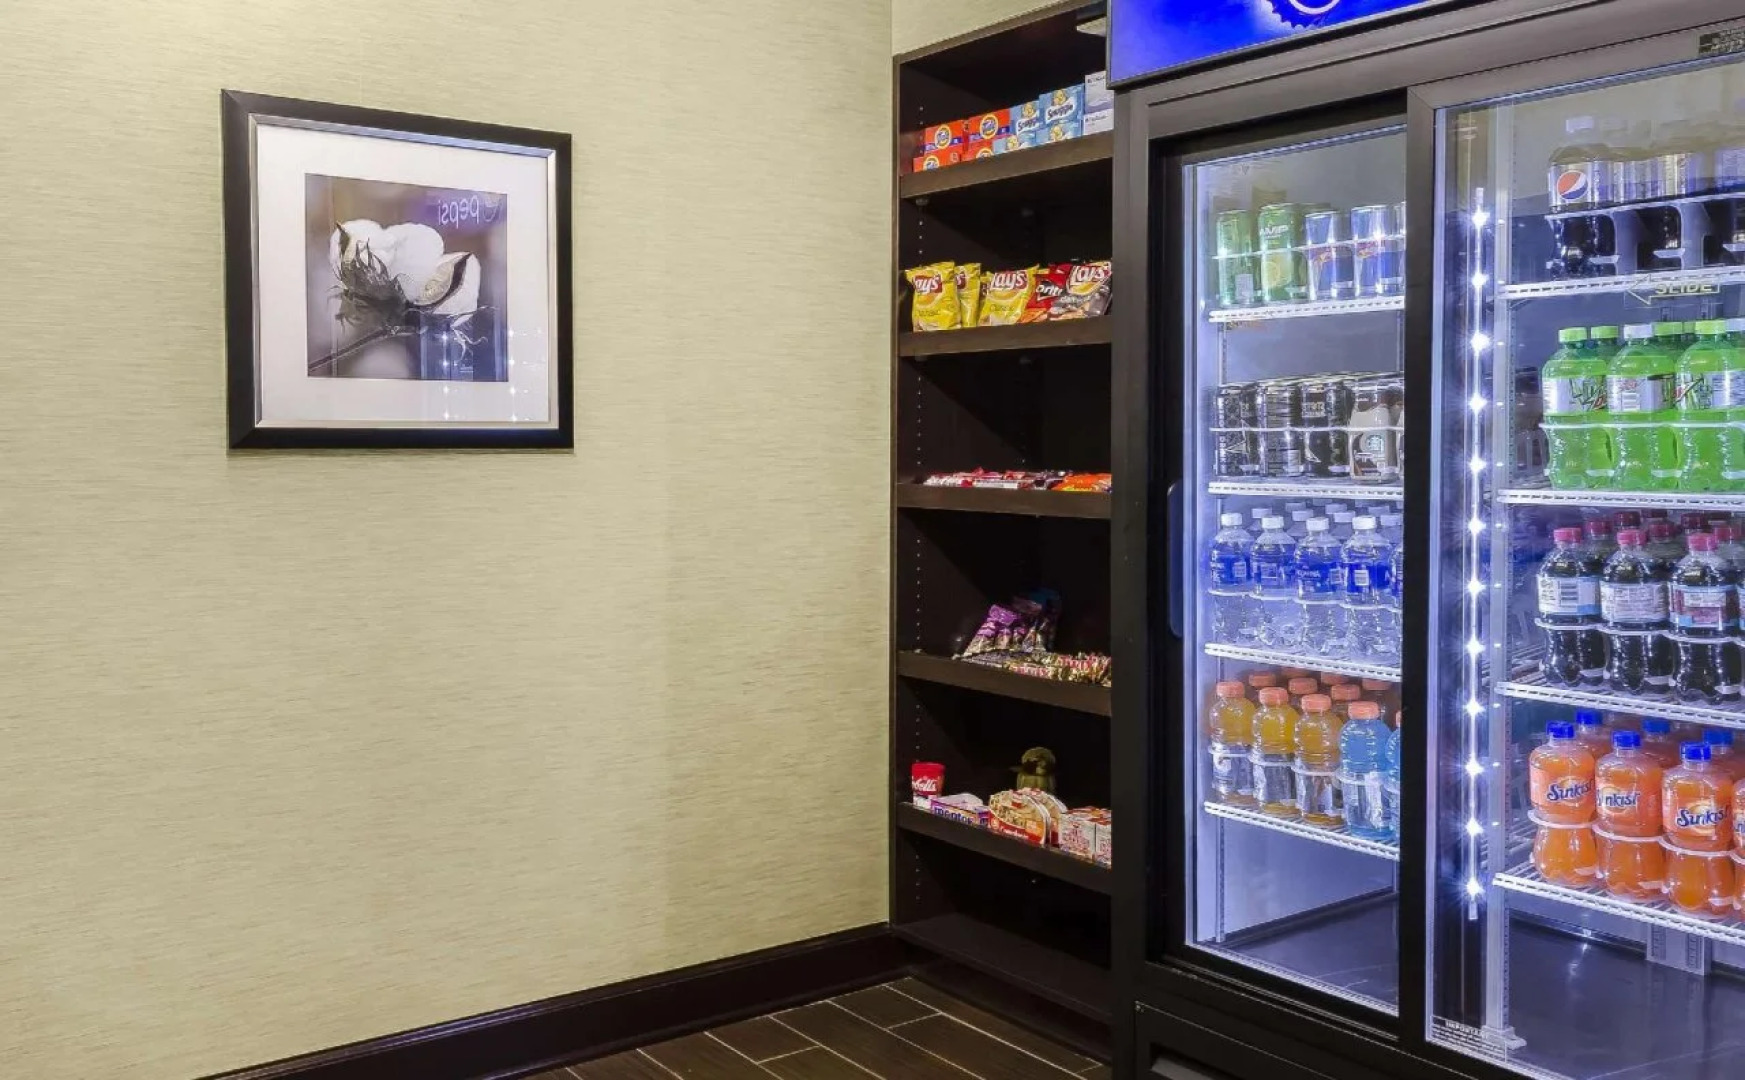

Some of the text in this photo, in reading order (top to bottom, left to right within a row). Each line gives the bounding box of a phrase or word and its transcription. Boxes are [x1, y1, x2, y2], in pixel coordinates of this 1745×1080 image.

[990, 270, 1024, 291] Lay's
[1655, 283, 1713, 296] SLIDE
[1597, 789, 1640, 807] nkist
